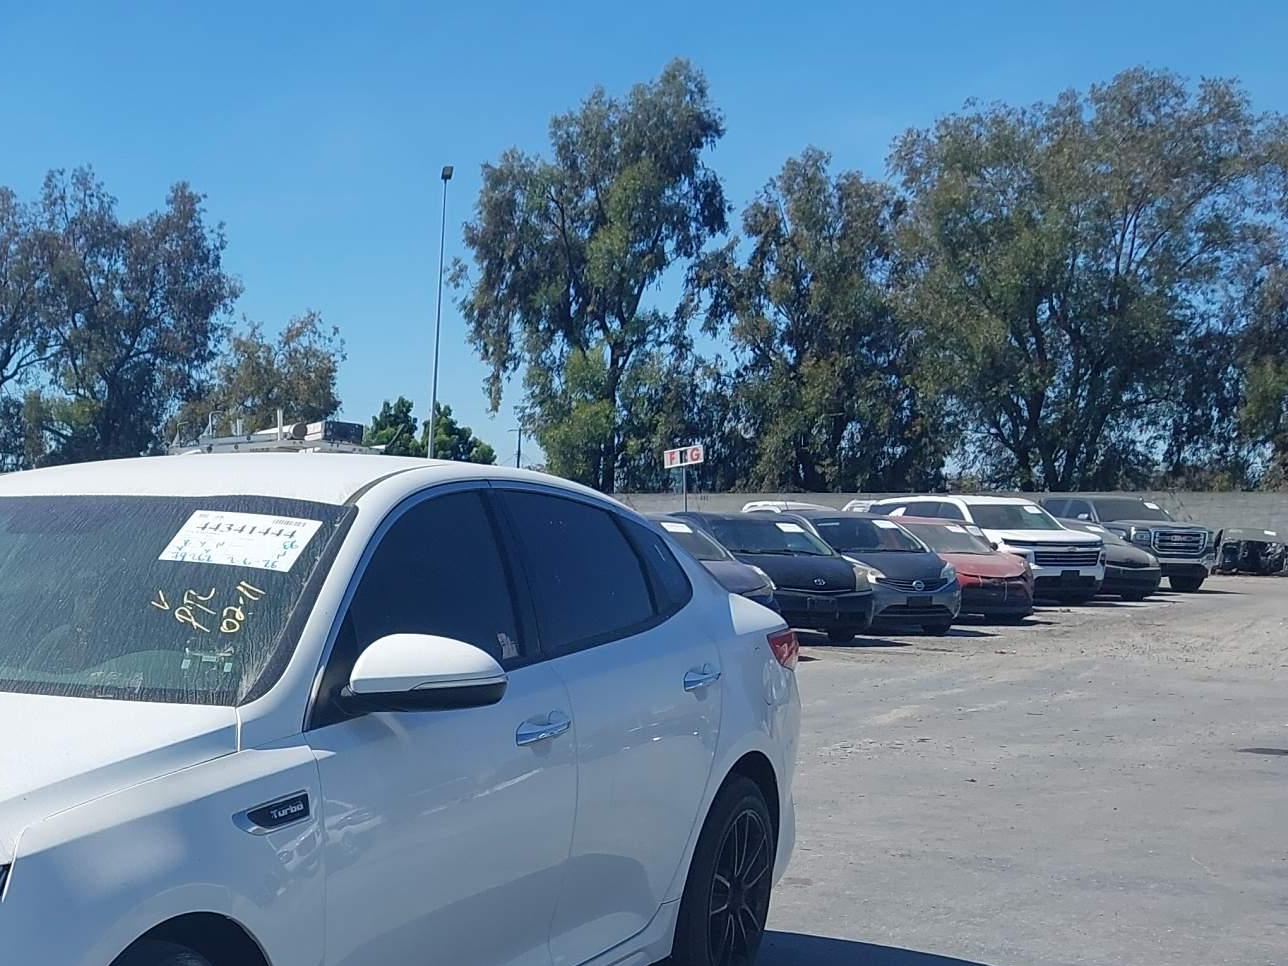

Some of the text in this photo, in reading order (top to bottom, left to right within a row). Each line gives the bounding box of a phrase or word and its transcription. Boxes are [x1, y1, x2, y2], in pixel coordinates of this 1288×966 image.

[690, 447, 700, 461] G
[196, 521, 297, 539] 44341444
[270, 801, 304, 820] Turbo
